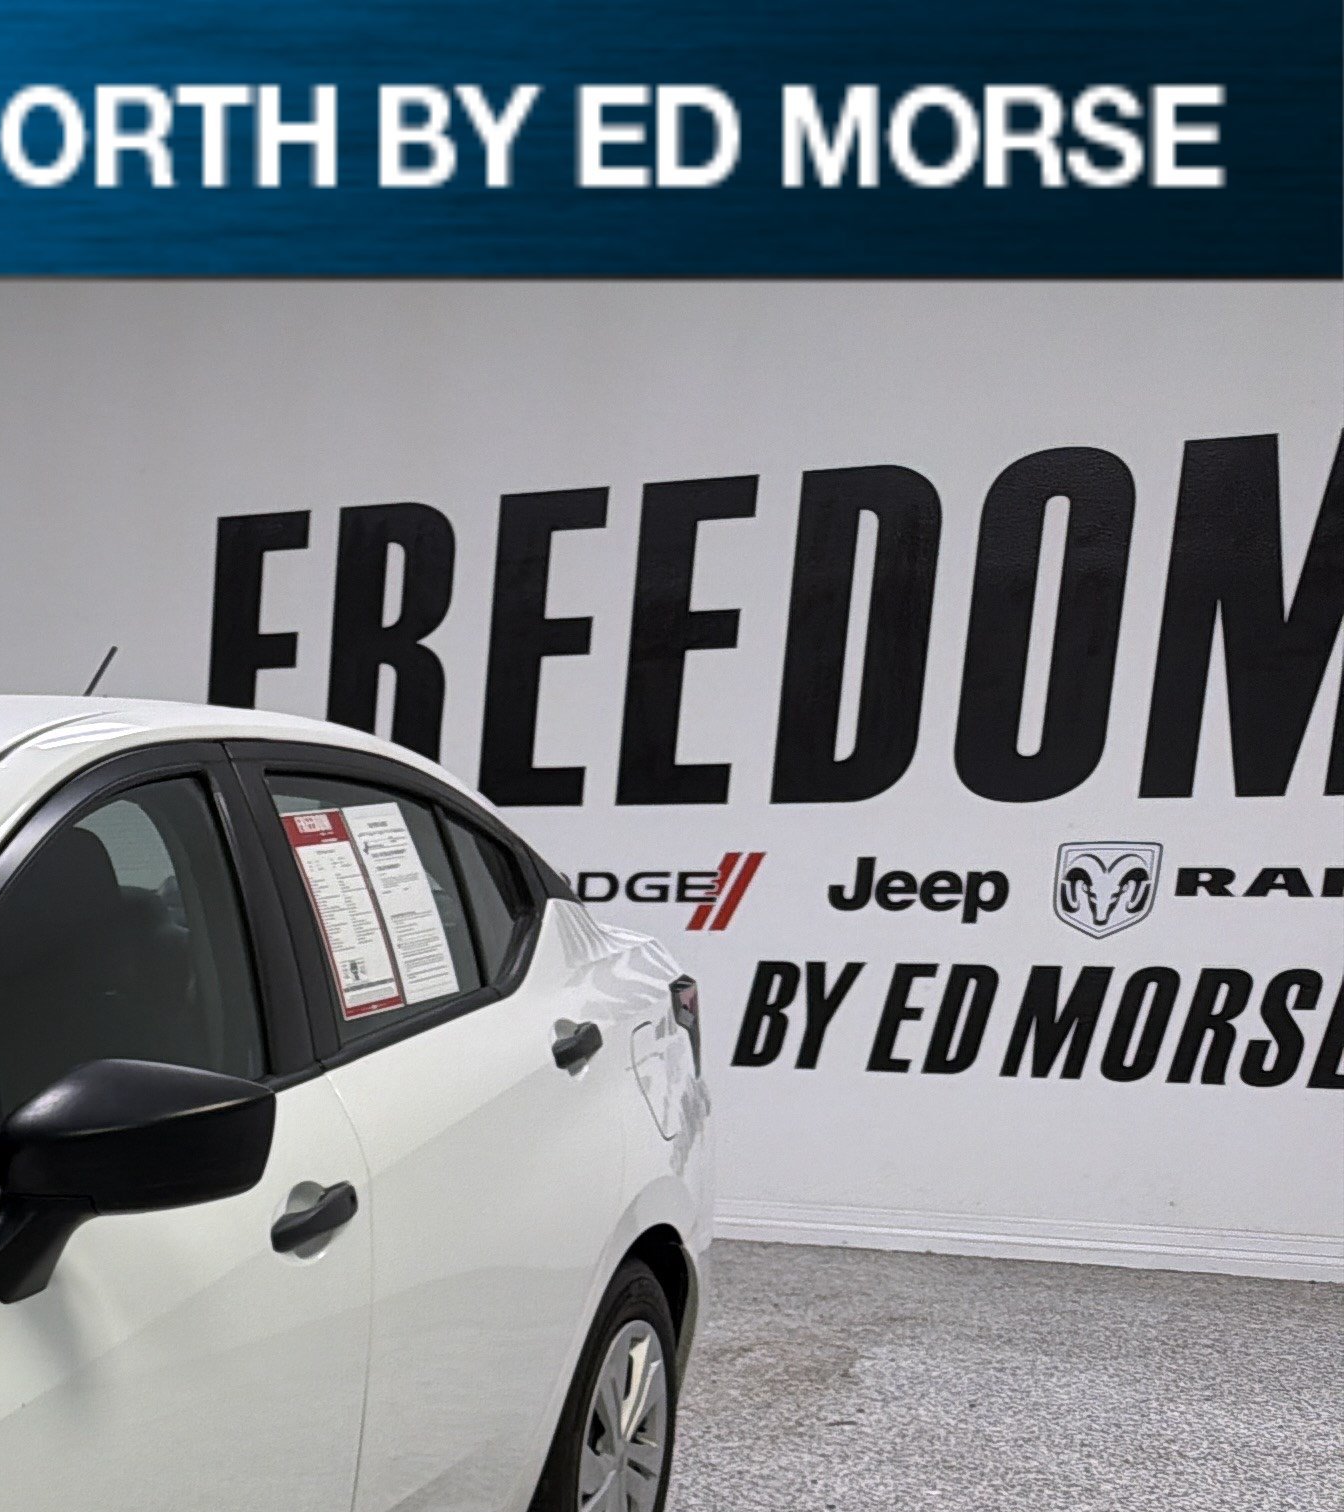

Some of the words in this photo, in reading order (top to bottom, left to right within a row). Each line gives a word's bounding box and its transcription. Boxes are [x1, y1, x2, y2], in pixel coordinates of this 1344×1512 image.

[205, 424, 1344, 808] FREEDOM
[562, 869, 720, 904] DGE
[827, 854, 1011, 925] Jeep
[730, 959, 867, 1071] BY
[865, 961, 1001, 1076] ED
